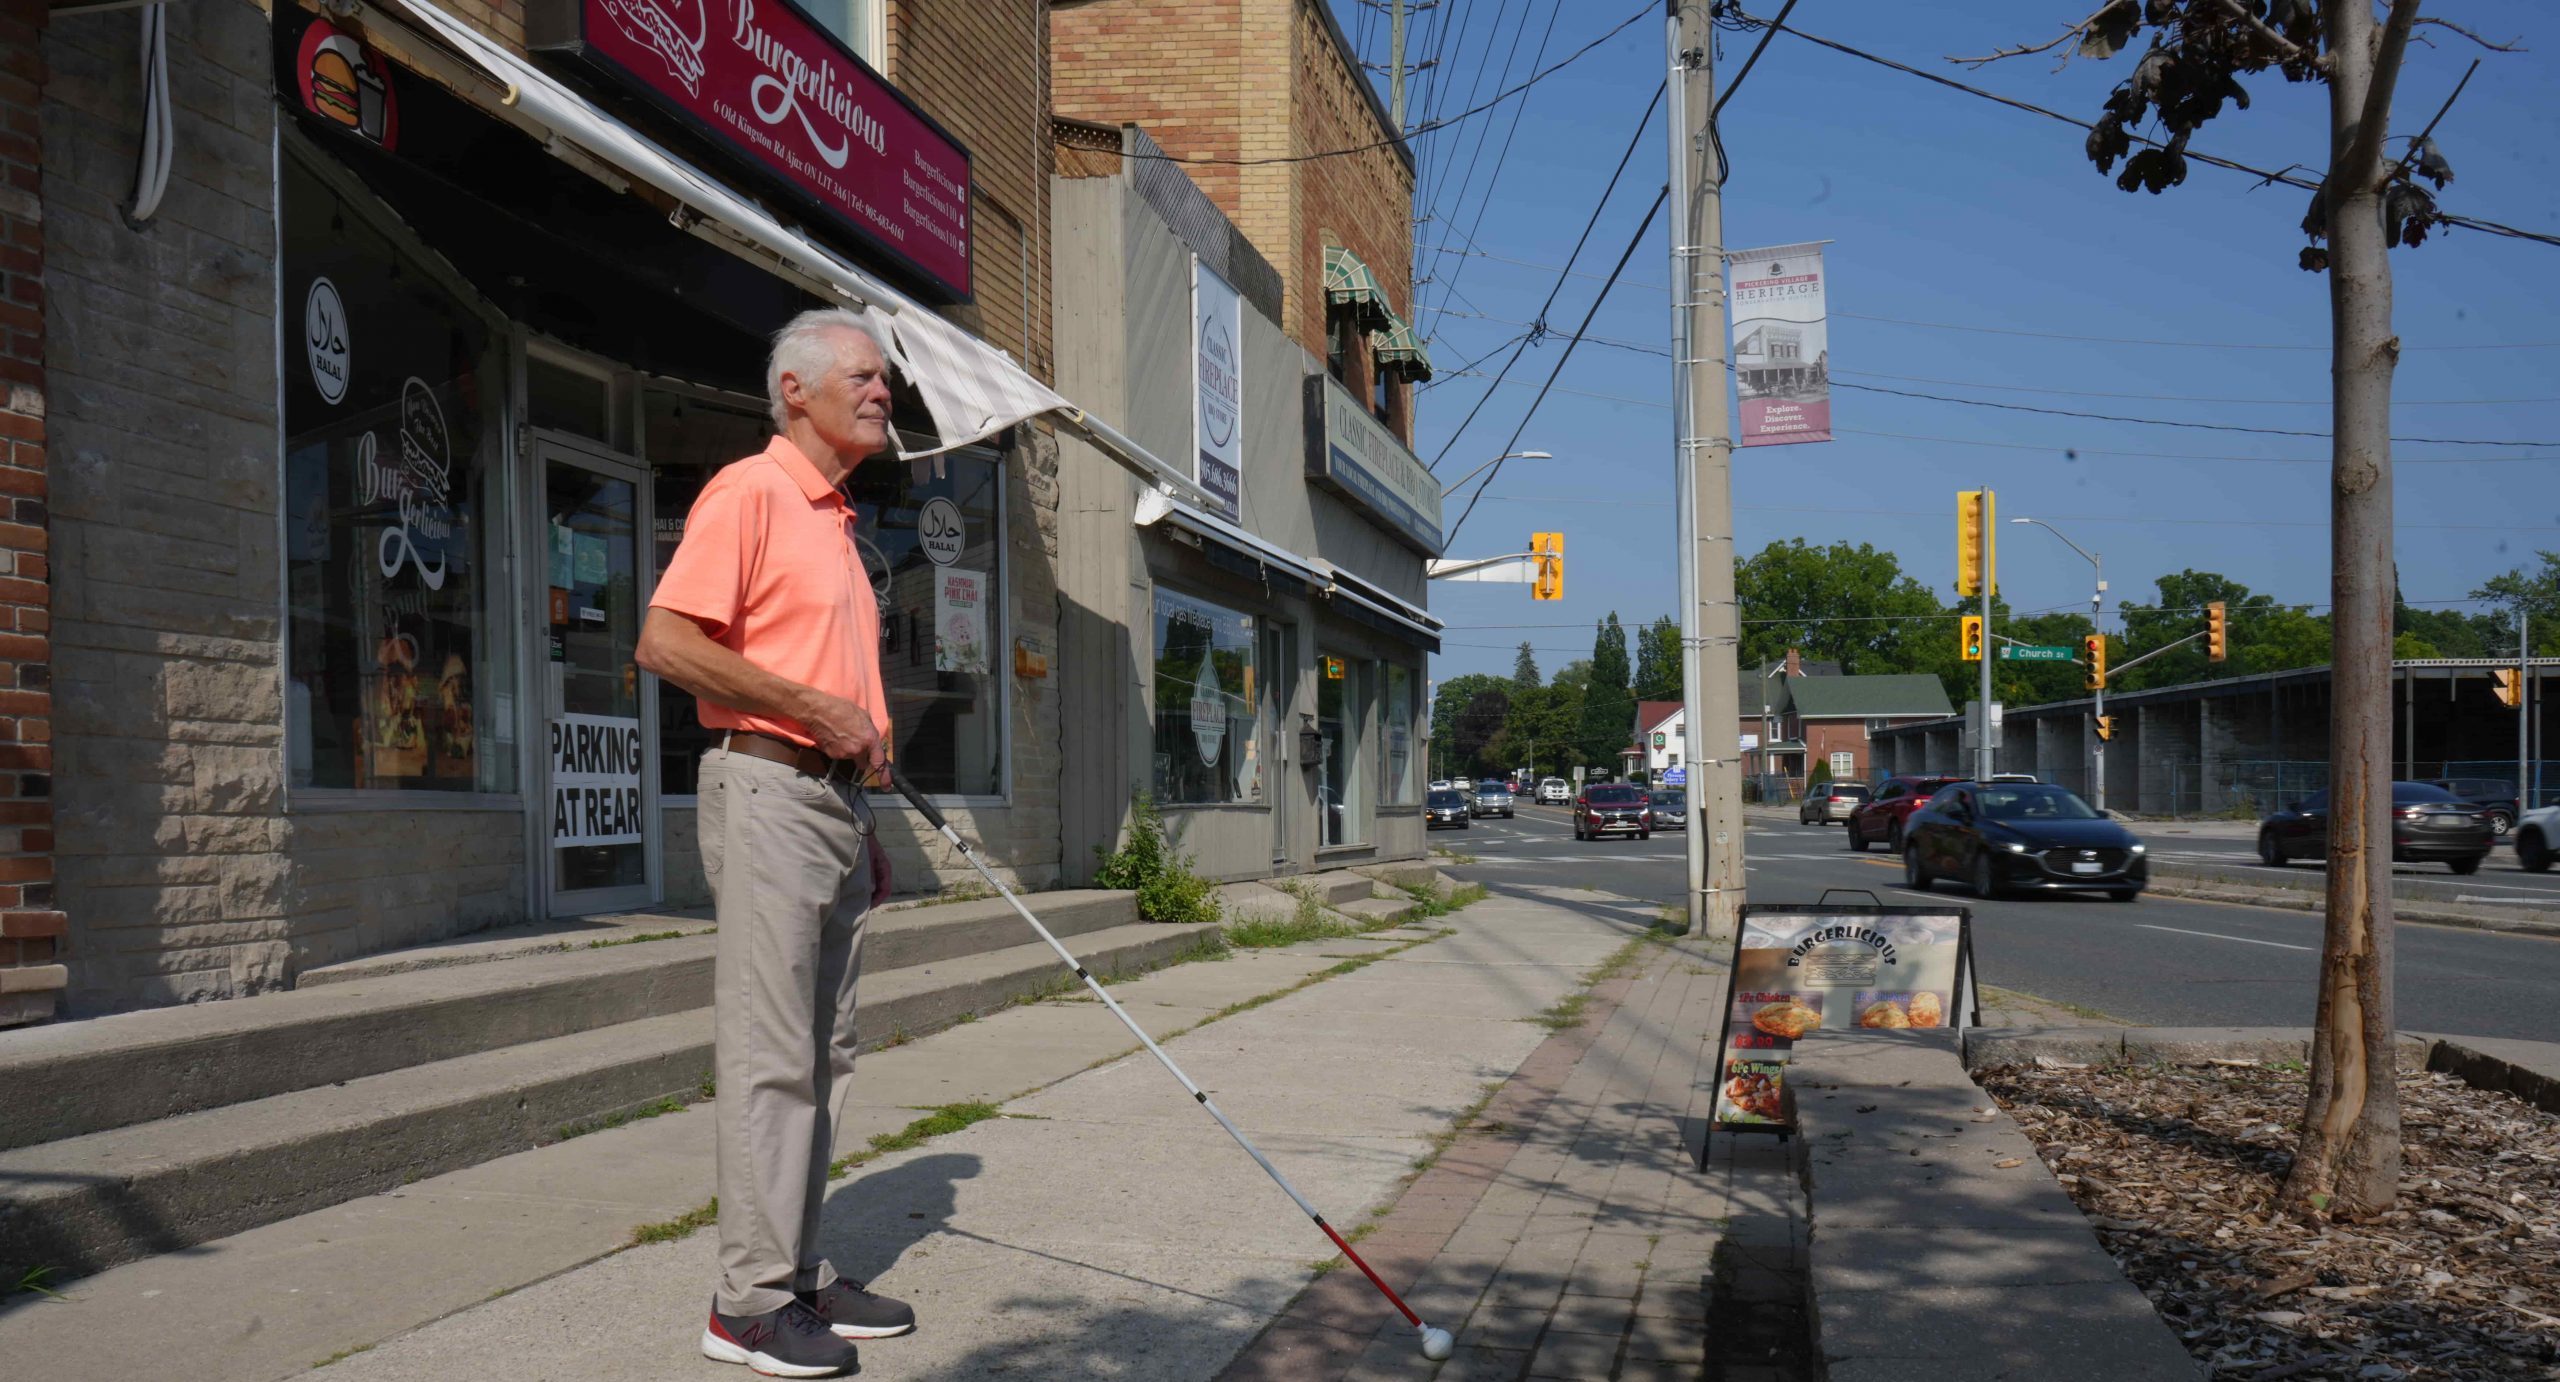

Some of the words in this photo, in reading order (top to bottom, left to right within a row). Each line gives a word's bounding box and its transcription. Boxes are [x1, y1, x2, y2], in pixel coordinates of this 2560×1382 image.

[728, 0, 887, 169] Burgerlicious
[713, 99, 719, 113] 6
[720, 103, 736, 125] Old
[737, 115, 773, 151] Kingston
[774, 140, 785, 159] Rd
[786, 149, 803, 173] Ajax
[804, 162, 817, 181] ON
[832, 181, 847, 201] 3A6
[851, 194, 864, 214] Tel:
[865, 203, 904, 242] 905-683-6161
[914, 149, 957, 195] Burgerlicious
[903, 168, 957, 222] Burgerlicious110
[903, 198, 957, 250] Burgerlicious110
[1736, 282, 1820, 301] HERITAGE
[1744, 278, 1780, 289] PICKERING
[1781, 275, 1808, 284] VILLAGE
[315, 354, 342, 381] HALAL
[1199, 352, 1238, 404] FIREPLACE
[1764, 413, 1805, 423] Discover.
[1766, 404, 1802, 415] Explore.
[1760, 422, 1810, 434] Experience.
[1339, 404, 1367, 457] CLASSIC
[1367, 427, 1401, 485] FIREPLACE
[922, 508, 961, 538] حلال
[928, 540, 956, 553] HALAL
[1175, 607, 1187, 626] gas
[2018, 648, 2053, 658] Church
[2055, 651, 2064, 659] St
[552, 723, 641, 775] PARKING
[553, 788, 581, 838] AT
[585, 787, 642, 837] REAR
[1787, 925, 1897, 967] BURGERLICIOUS
[1756, 991, 1791, 1003] Chicken
